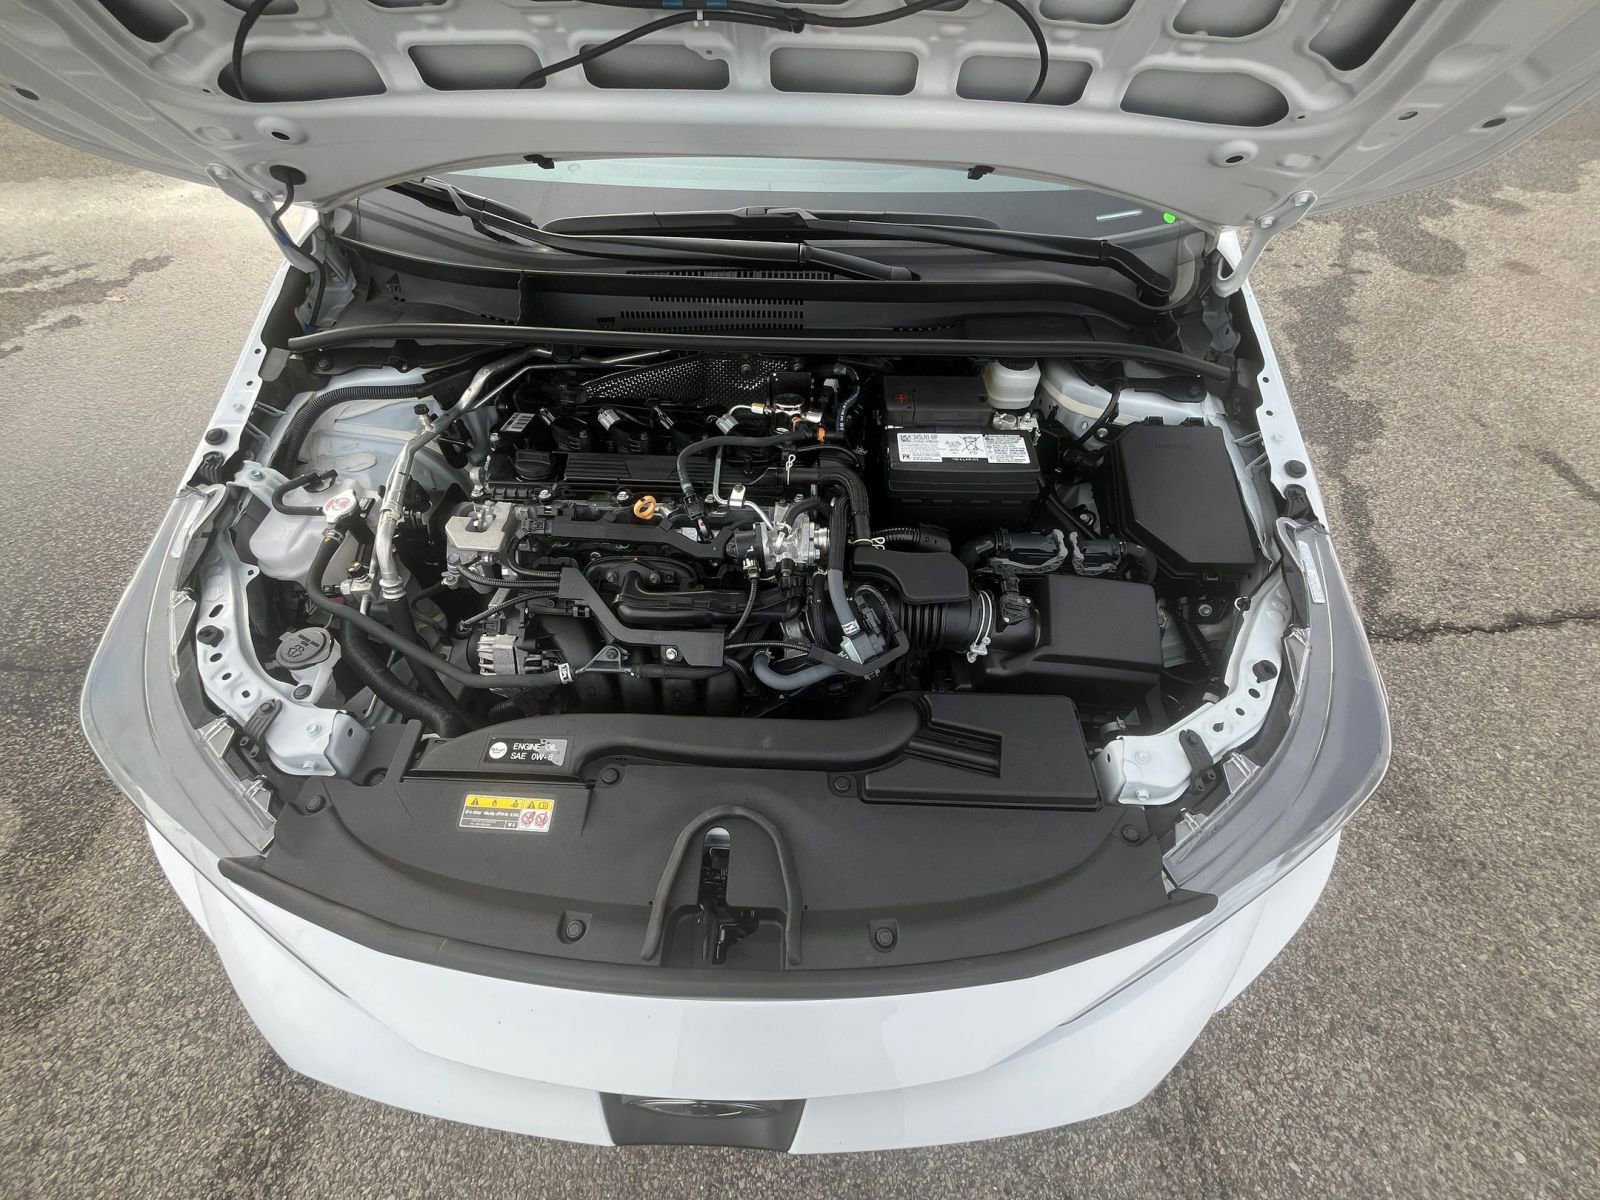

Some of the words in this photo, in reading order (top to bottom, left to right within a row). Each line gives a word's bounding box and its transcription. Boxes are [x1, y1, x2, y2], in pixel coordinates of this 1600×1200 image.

[513, 742, 541, 751] ENGINE
[545, 743, 558, 752] OIL
[510, 752, 528, 760] SAE
